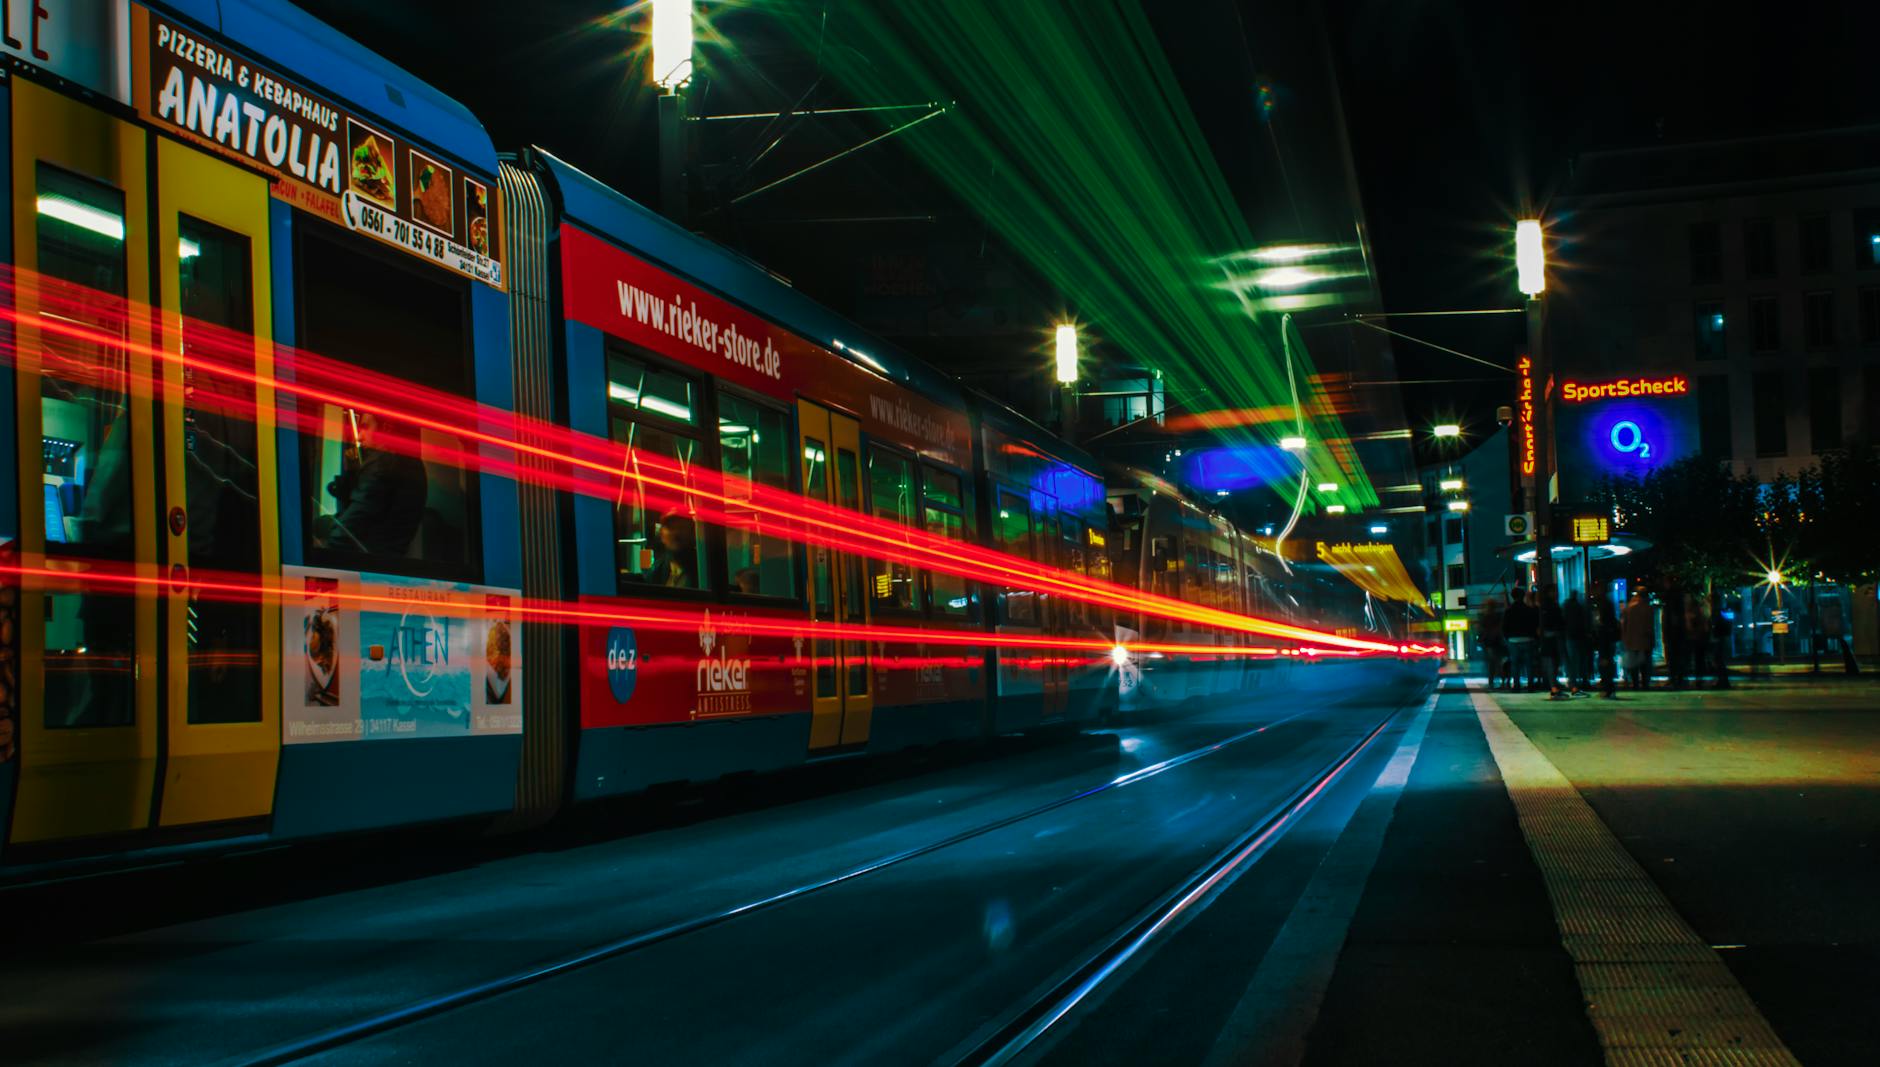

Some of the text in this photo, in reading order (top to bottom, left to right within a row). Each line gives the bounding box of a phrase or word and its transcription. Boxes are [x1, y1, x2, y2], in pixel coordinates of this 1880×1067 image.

[158, 23, 339, 132] PIZZERIA & KEBAPHAUS
[158, 66, 341, 194] ANATOLIA
[361, 206, 384, 234] 0561
[394, 219, 410, 245] 701
[412, 228, 424, 251] 55
[425, 234, 432, 255] 4
[617, 279, 781, 380] www.rieker-store.de
[1563, 377, 1686, 402] SportScheck
[1316, 541, 1394, 558] 5 nicht einsteigen
[388, 586, 451, 604] RESTAURANT
[386, 616, 449, 677] ATHEN
[608, 640, 635, 671] dez
[697, 645, 751, 691] rieker
[393, 717, 416, 733] Kassel
